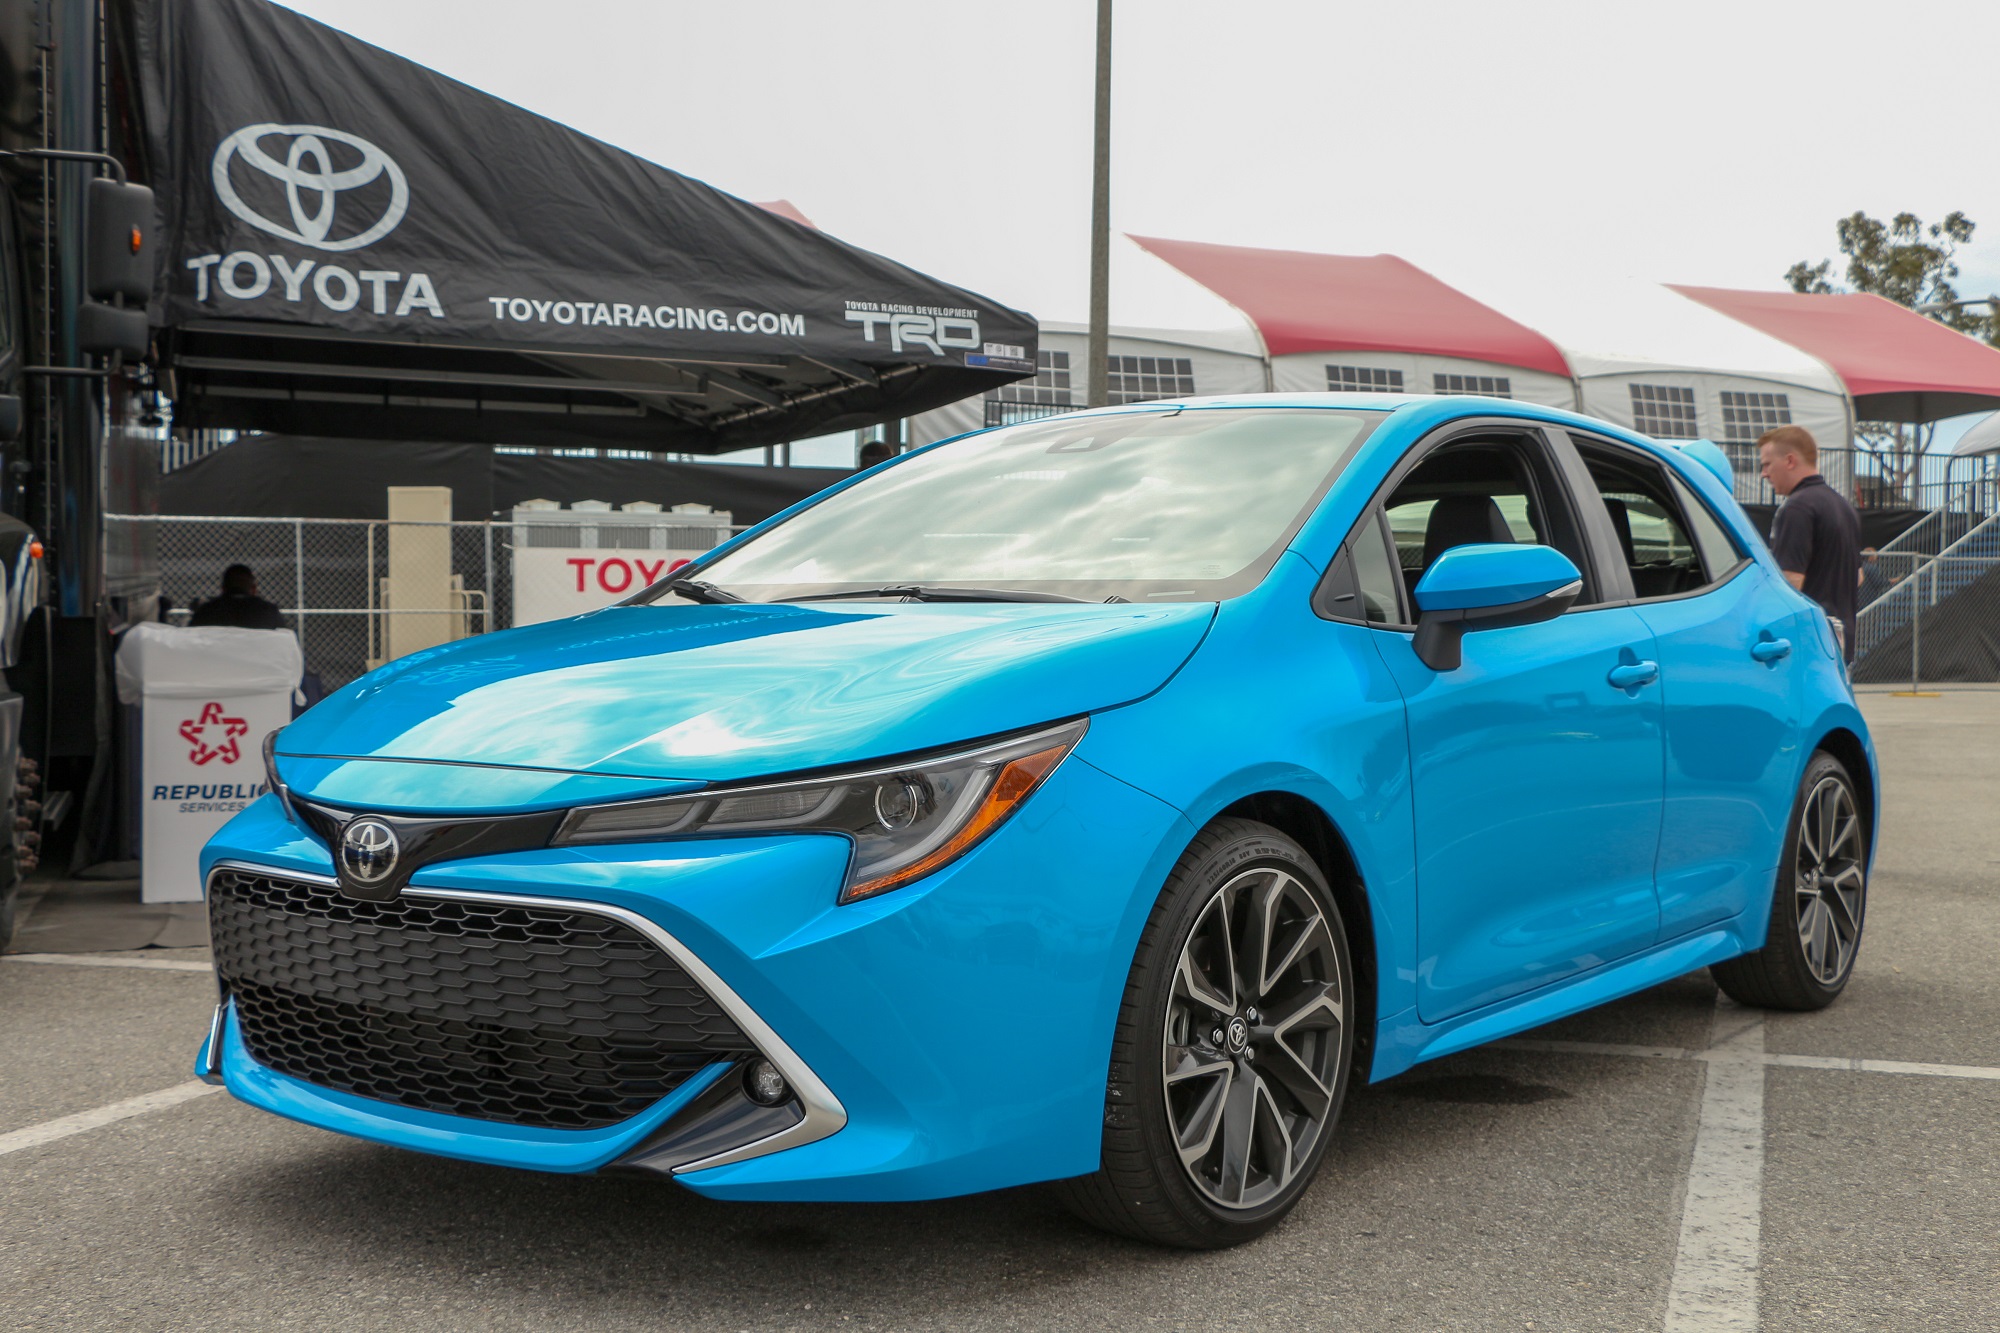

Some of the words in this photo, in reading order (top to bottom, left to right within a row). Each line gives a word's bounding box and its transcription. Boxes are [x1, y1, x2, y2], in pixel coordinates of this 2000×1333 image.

[186, 251, 445, 317] TOYOTA
[488, 297, 806, 336] TOYOTARACING.COM
[845, 300, 878, 312] TOYOTA
[881, 303, 914, 315] RACING
[916, 307, 979, 319] DEVELOPMENT
[845, 310, 981, 357] TRD
[178, 801, 247, 813] SERVICES
